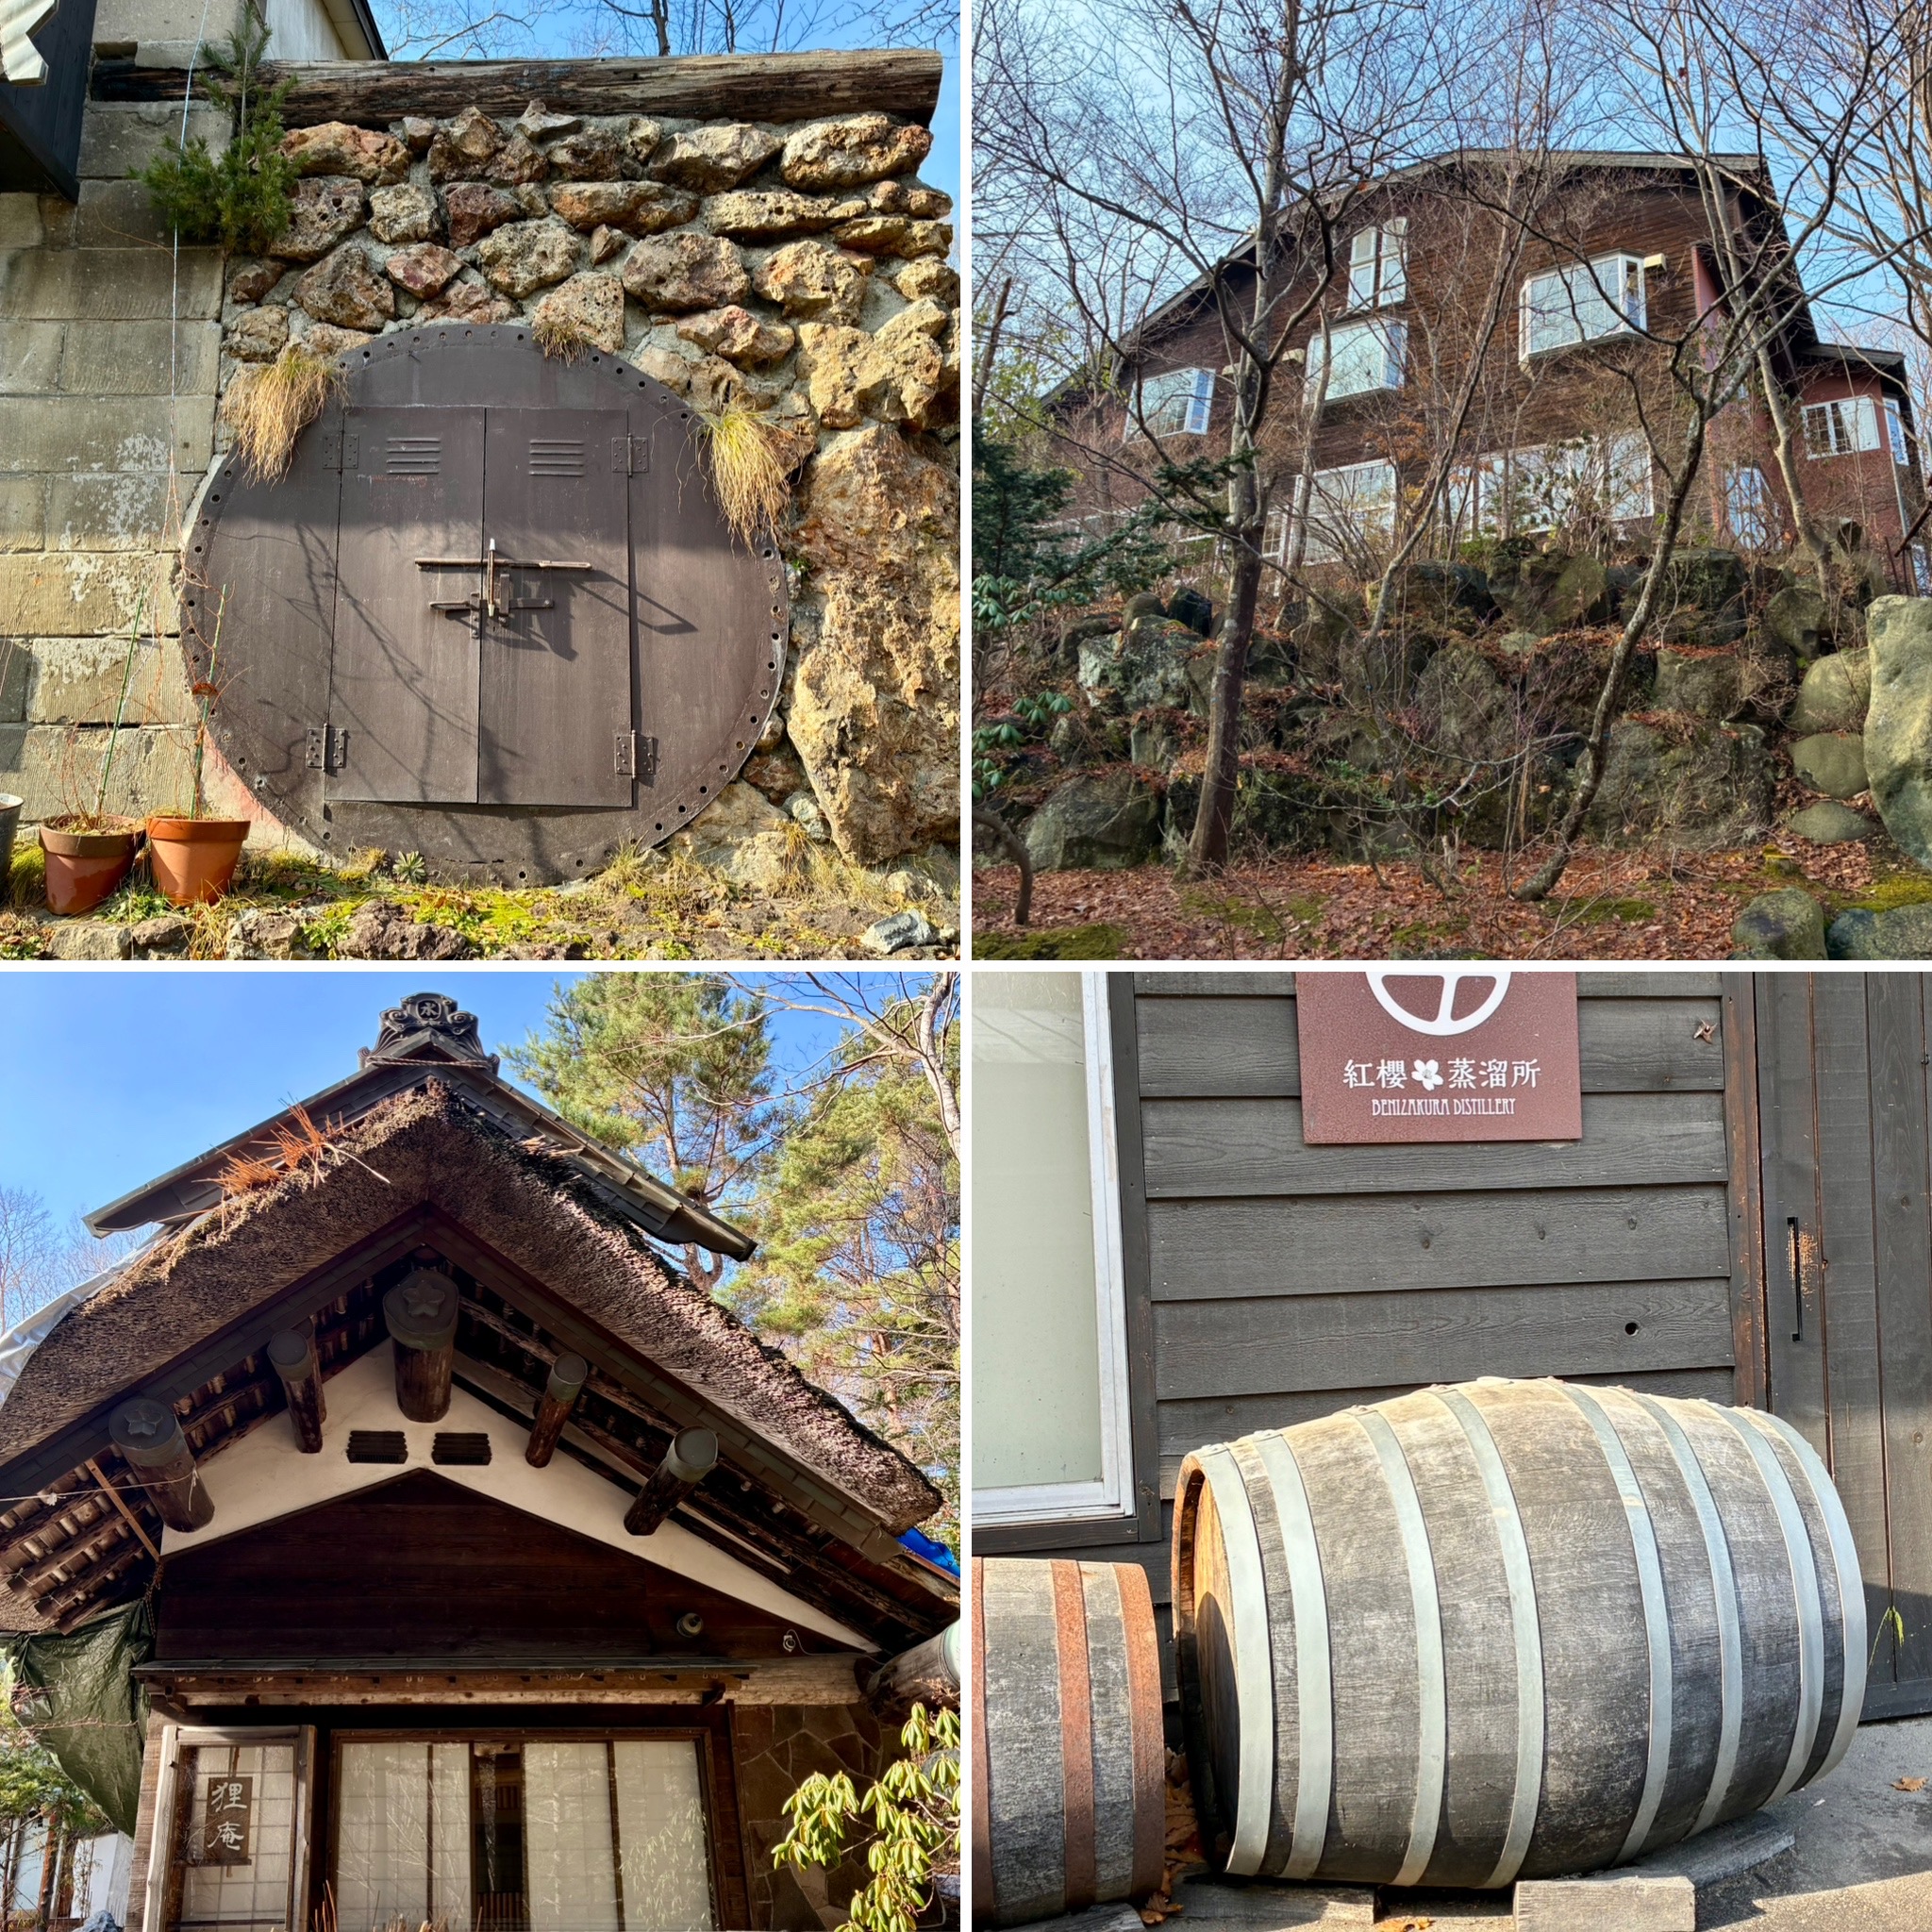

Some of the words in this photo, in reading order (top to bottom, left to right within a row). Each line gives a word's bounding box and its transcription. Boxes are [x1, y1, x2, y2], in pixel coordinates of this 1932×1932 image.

[1342, 1058, 1407, 1090] 紅櫻
[1447, 1058, 1541, 1090] 蒸溜所
[1372, 1098, 1450, 1116] BENIZAKURA
[1453, 1098, 1516, 1115] DISTILLERY
